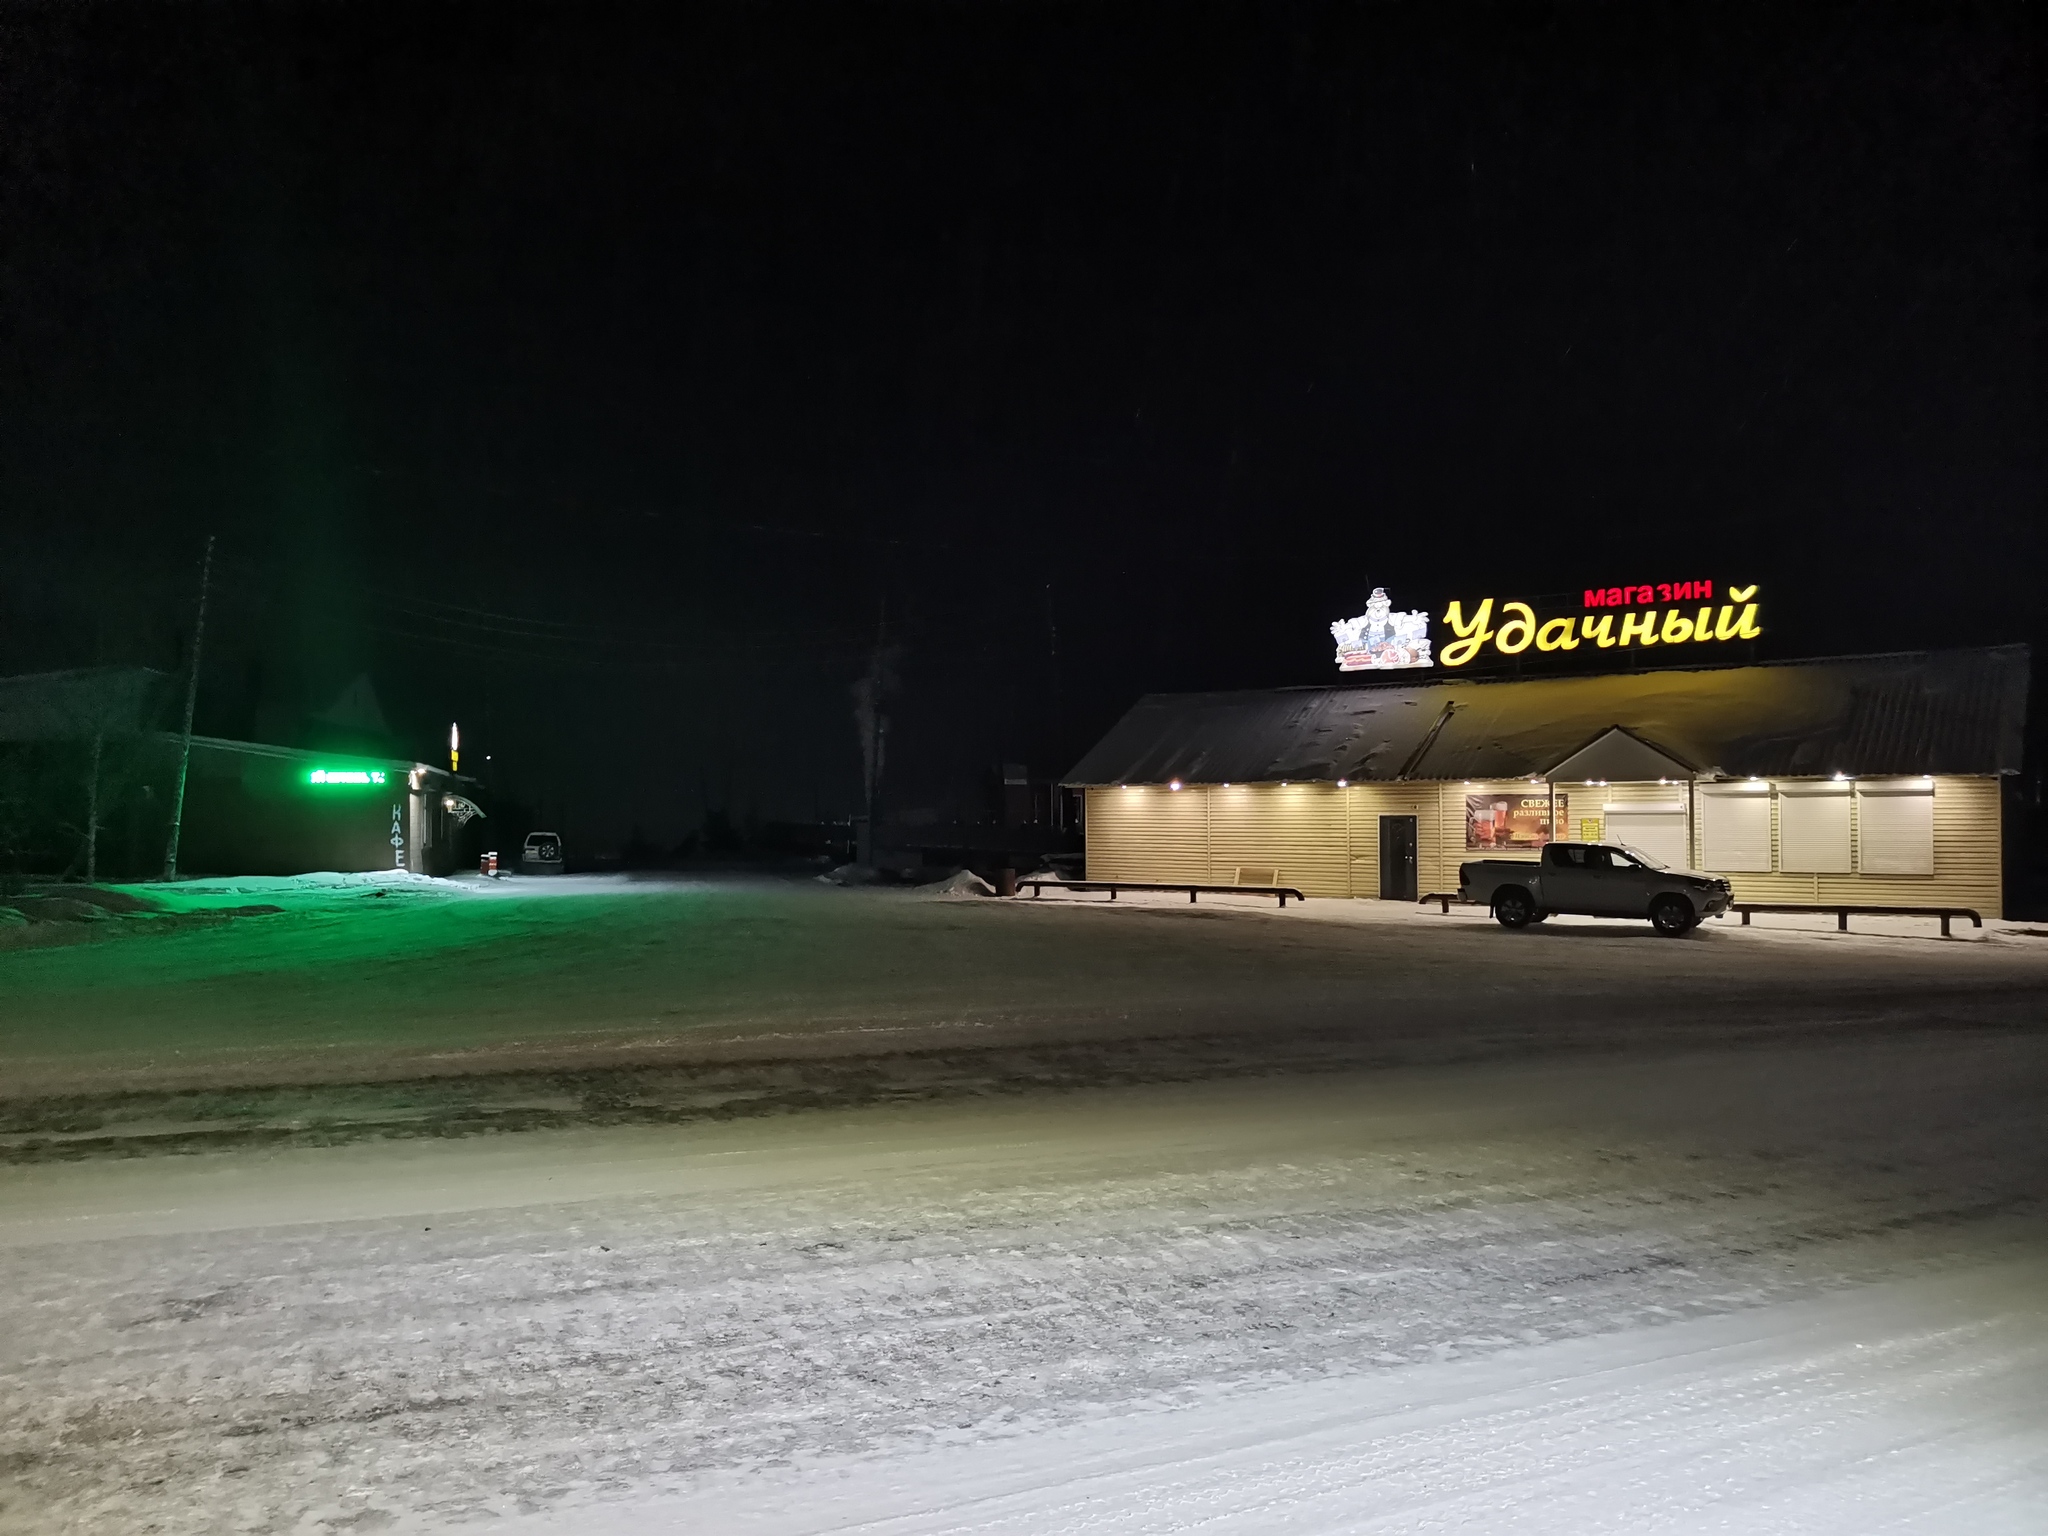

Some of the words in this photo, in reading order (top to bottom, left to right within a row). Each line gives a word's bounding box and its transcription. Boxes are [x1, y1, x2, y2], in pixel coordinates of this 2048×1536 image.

[1440, 584, 1761, 667] Удачный
[1583, 579, 1713, 609] магазин
[390, 804, 405, 867] КАФЕ
